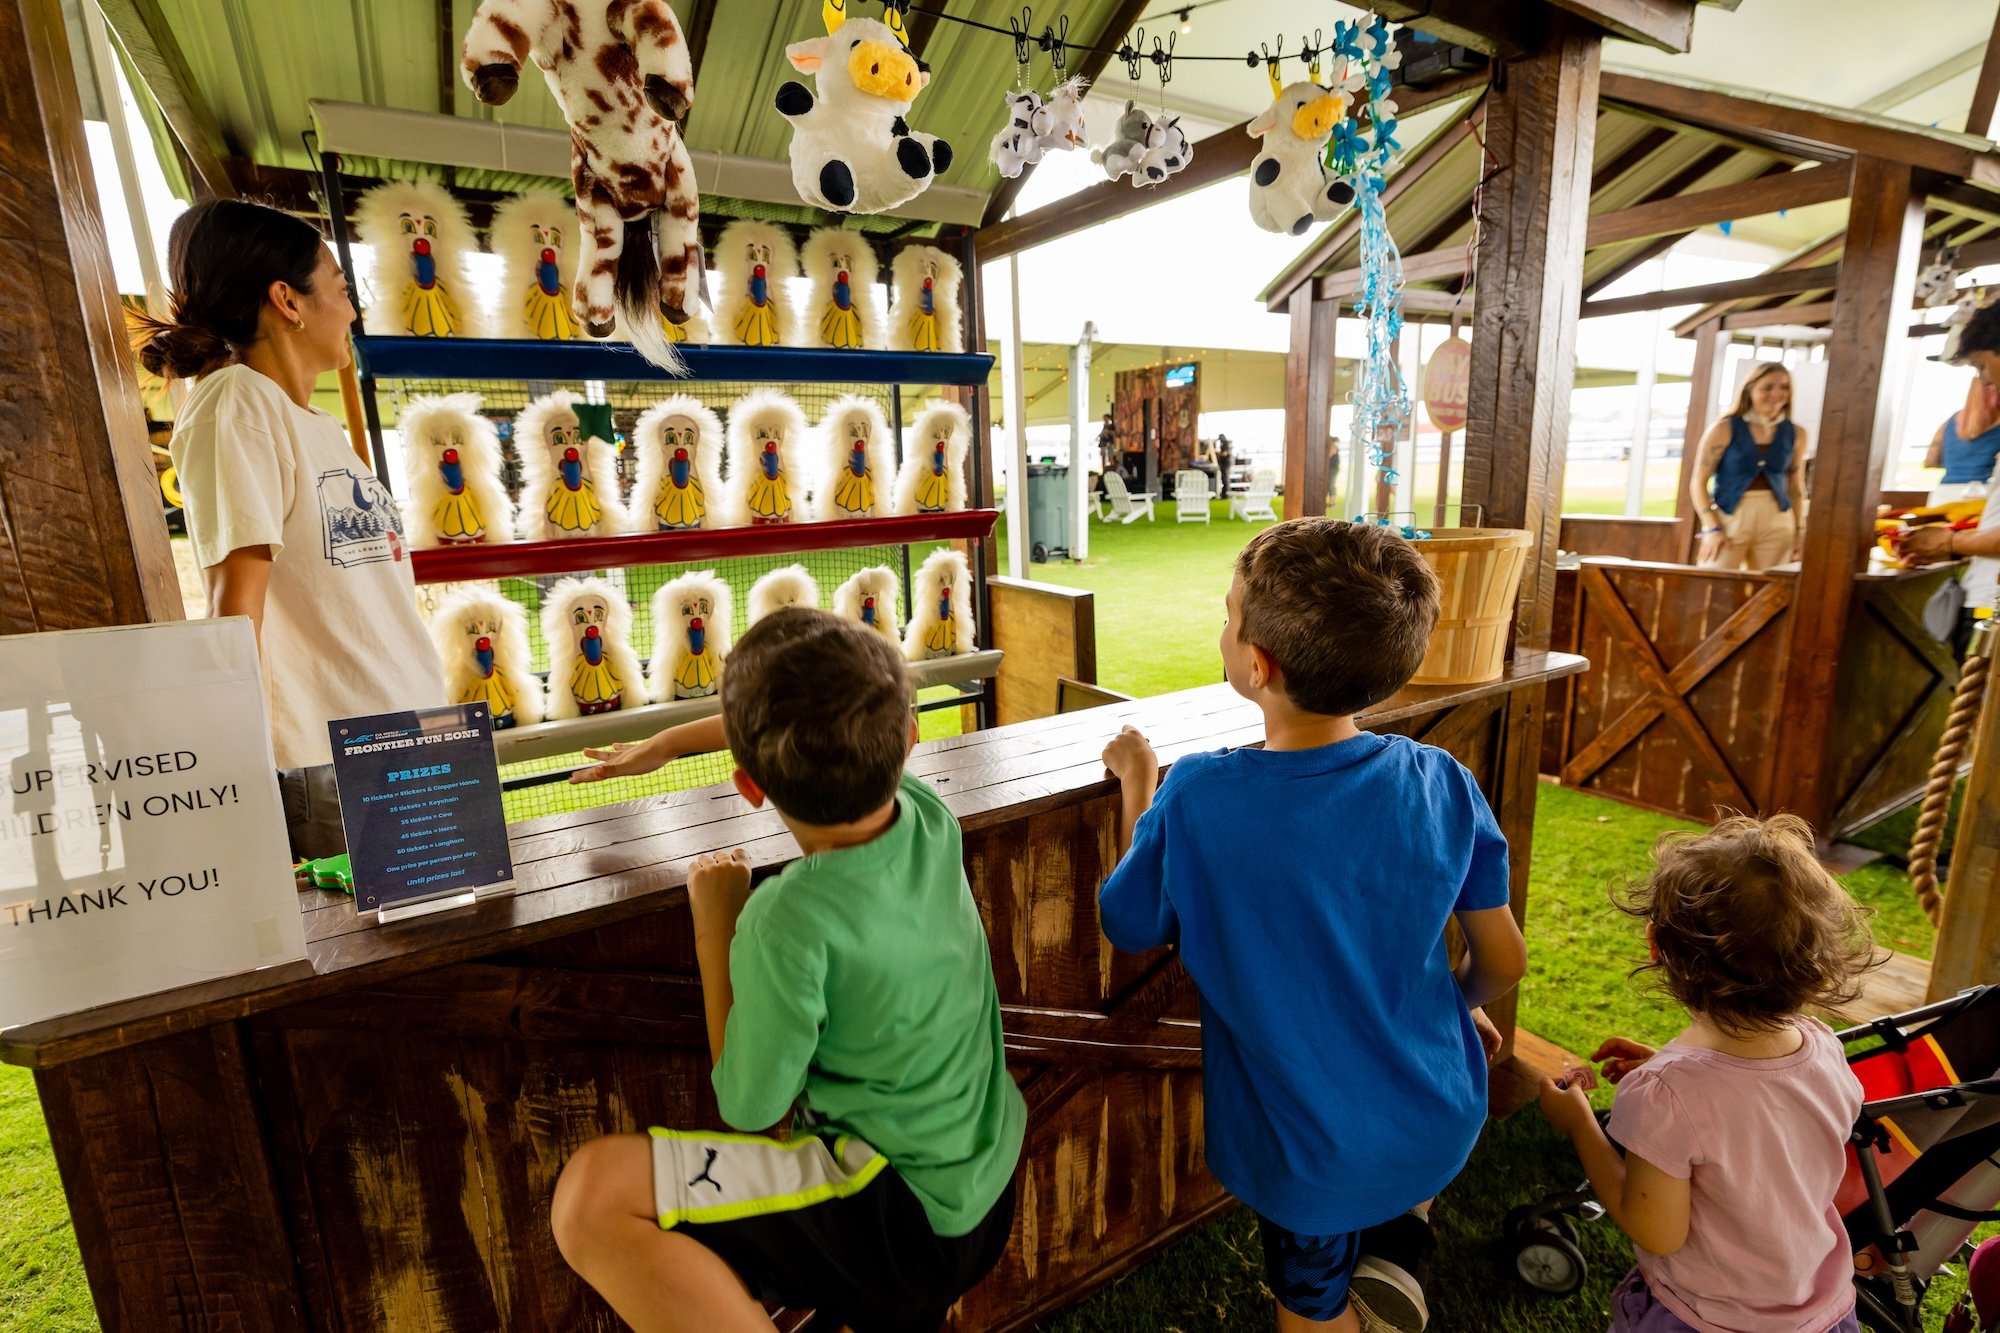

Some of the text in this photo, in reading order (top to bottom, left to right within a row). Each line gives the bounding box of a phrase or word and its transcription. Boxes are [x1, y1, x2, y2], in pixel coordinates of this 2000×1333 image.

[343, 729, 480, 756] FRONTIER FUN ZONE
[387, 763, 452, 783] PRIZES
[371, 793, 394, 802] tickets
[400, 787, 426, 797] Stickers
[433, 782, 459, 793] Clapper
[459, 778, 480, 787] Hands
[143, 784, 239, 817] ONLY!
[399, 803, 421, 812] tickets
[428, 796, 459, 808] Keychain
[410, 815, 432, 824] tickets
[438, 811, 453, 819] Cow
[410, 829, 432, 838] tickets
[438, 824, 457, 833] Horse
[406, 844, 428, 853] tickets
[434, 837, 465, 849] Longhorn
[401, 862, 417, 871] prize
[418, 860, 429, 868] per
[429, 856, 451, 867] person
[452, 853, 463, 862] per
[464, 850, 479, 859] day.
[406, 869, 465, 887] Until prizes last
[4, 868, 220, 926] THANK YOU!
